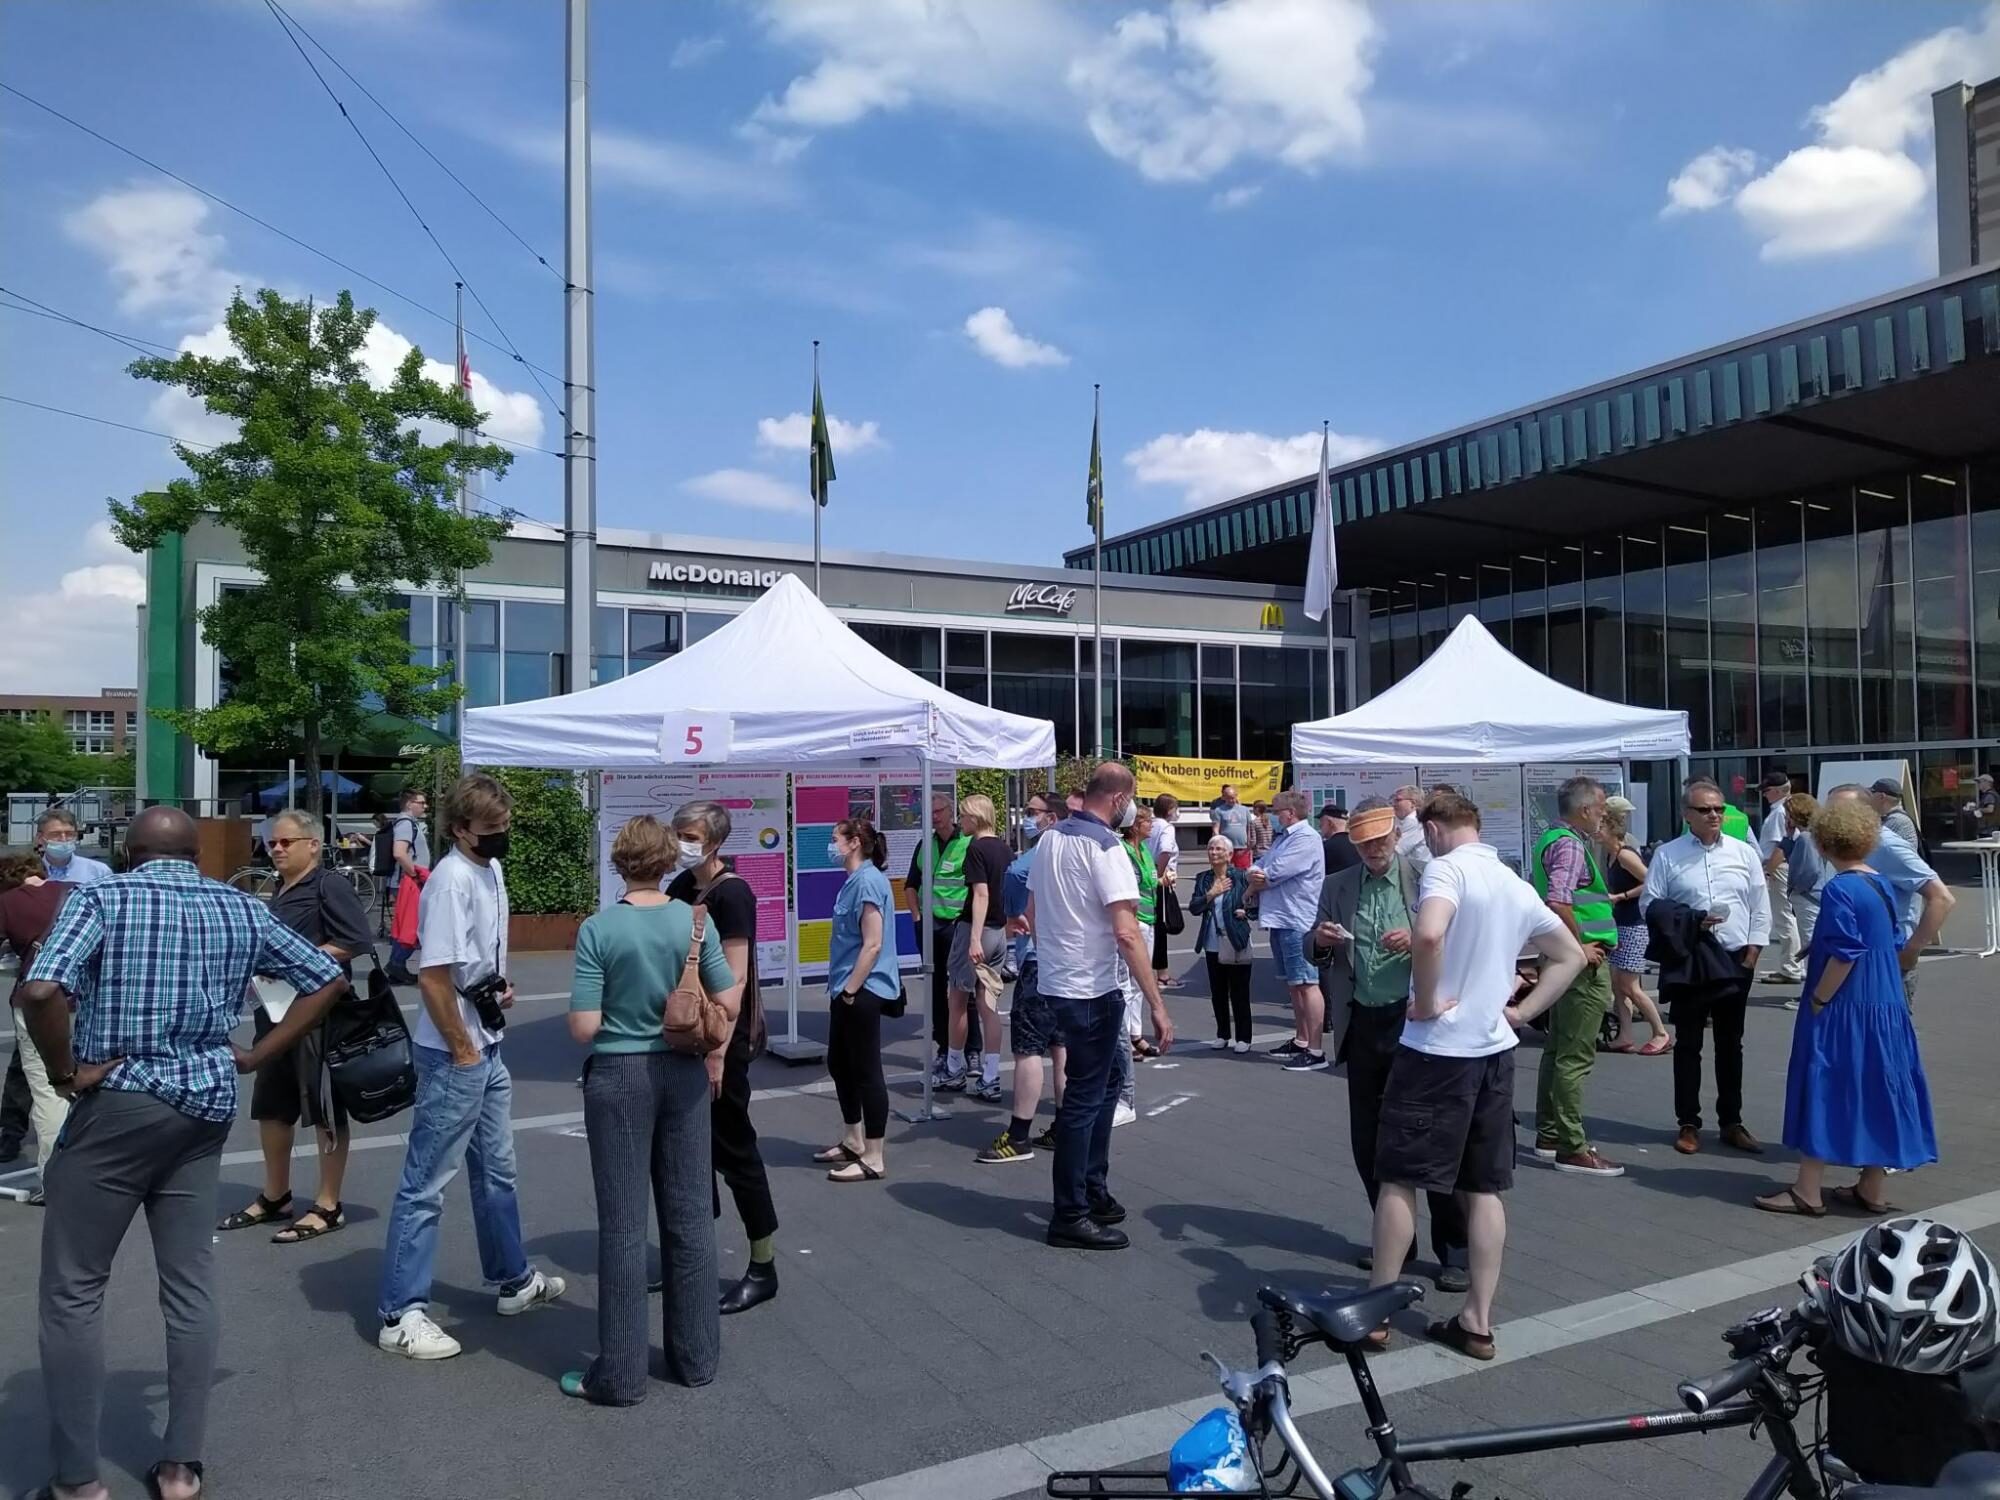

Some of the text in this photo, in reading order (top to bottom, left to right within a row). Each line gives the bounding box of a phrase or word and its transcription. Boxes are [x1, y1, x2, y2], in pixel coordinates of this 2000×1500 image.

[649, 561, 782, 588] McDonald'
[1008, 583, 1077, 613] McCafé
[684, 726, 703, 755] 5
[1139, 759, 1159, 774] Wir
[1162, 763, 1200, 777] haben
[1204, 765, 1258, 780] geöffnet.
